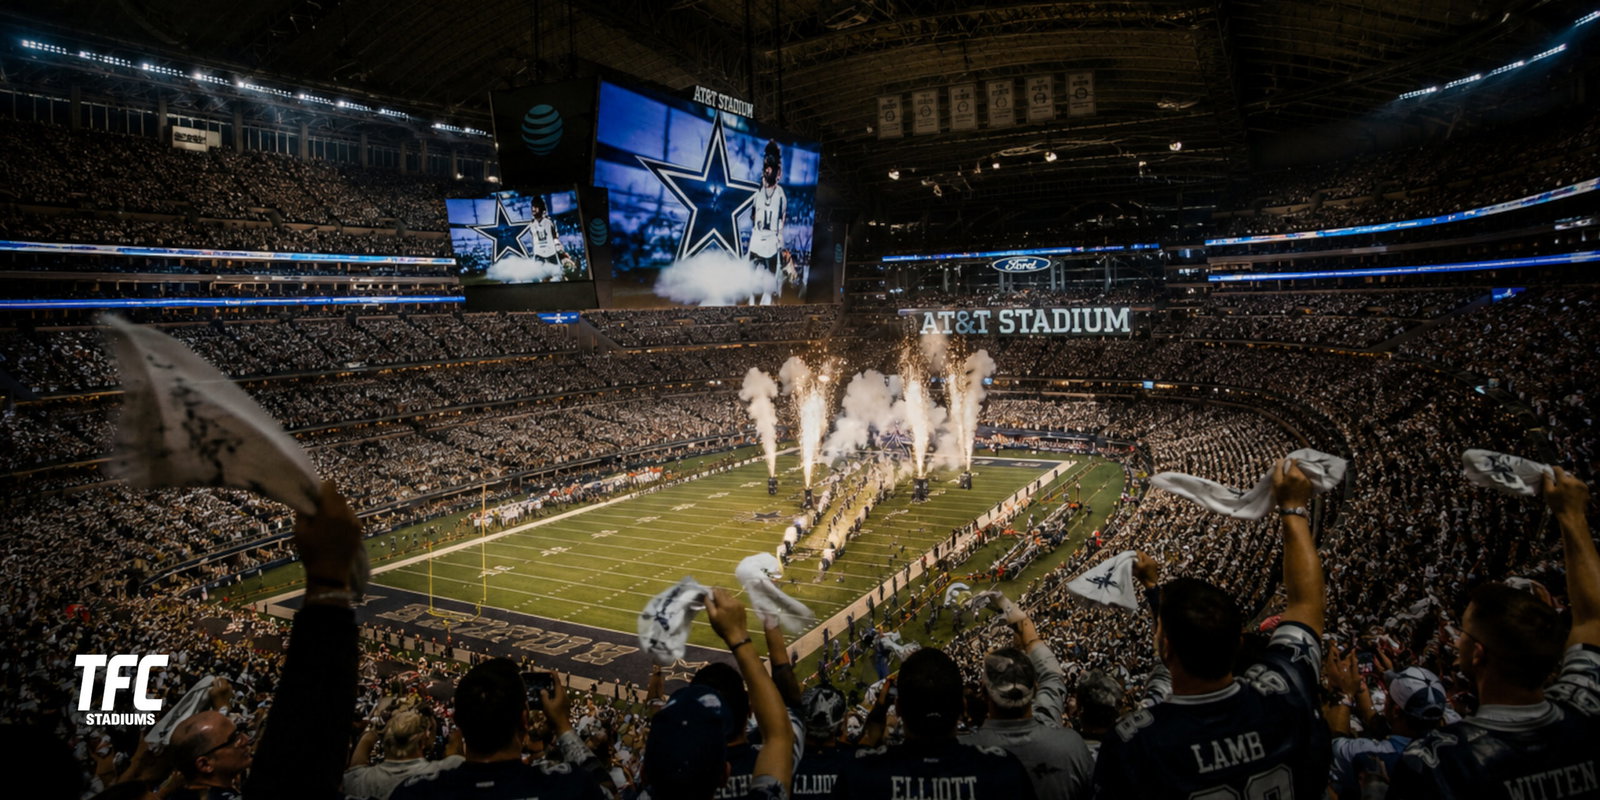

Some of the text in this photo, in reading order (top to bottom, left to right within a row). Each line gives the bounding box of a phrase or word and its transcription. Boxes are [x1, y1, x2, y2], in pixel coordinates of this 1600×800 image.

[694, 85, 754, 119] AT&T STADIUM
[1005, 258, 1038, 271] Ford
[920, 307, 1131, 335] AT&T STADIUM
[1190, 730, 1267, 774] LAMB
[890, 776, 978, 800] ELLIOTT
[1503, 759, 1599, 800] WITTEN
